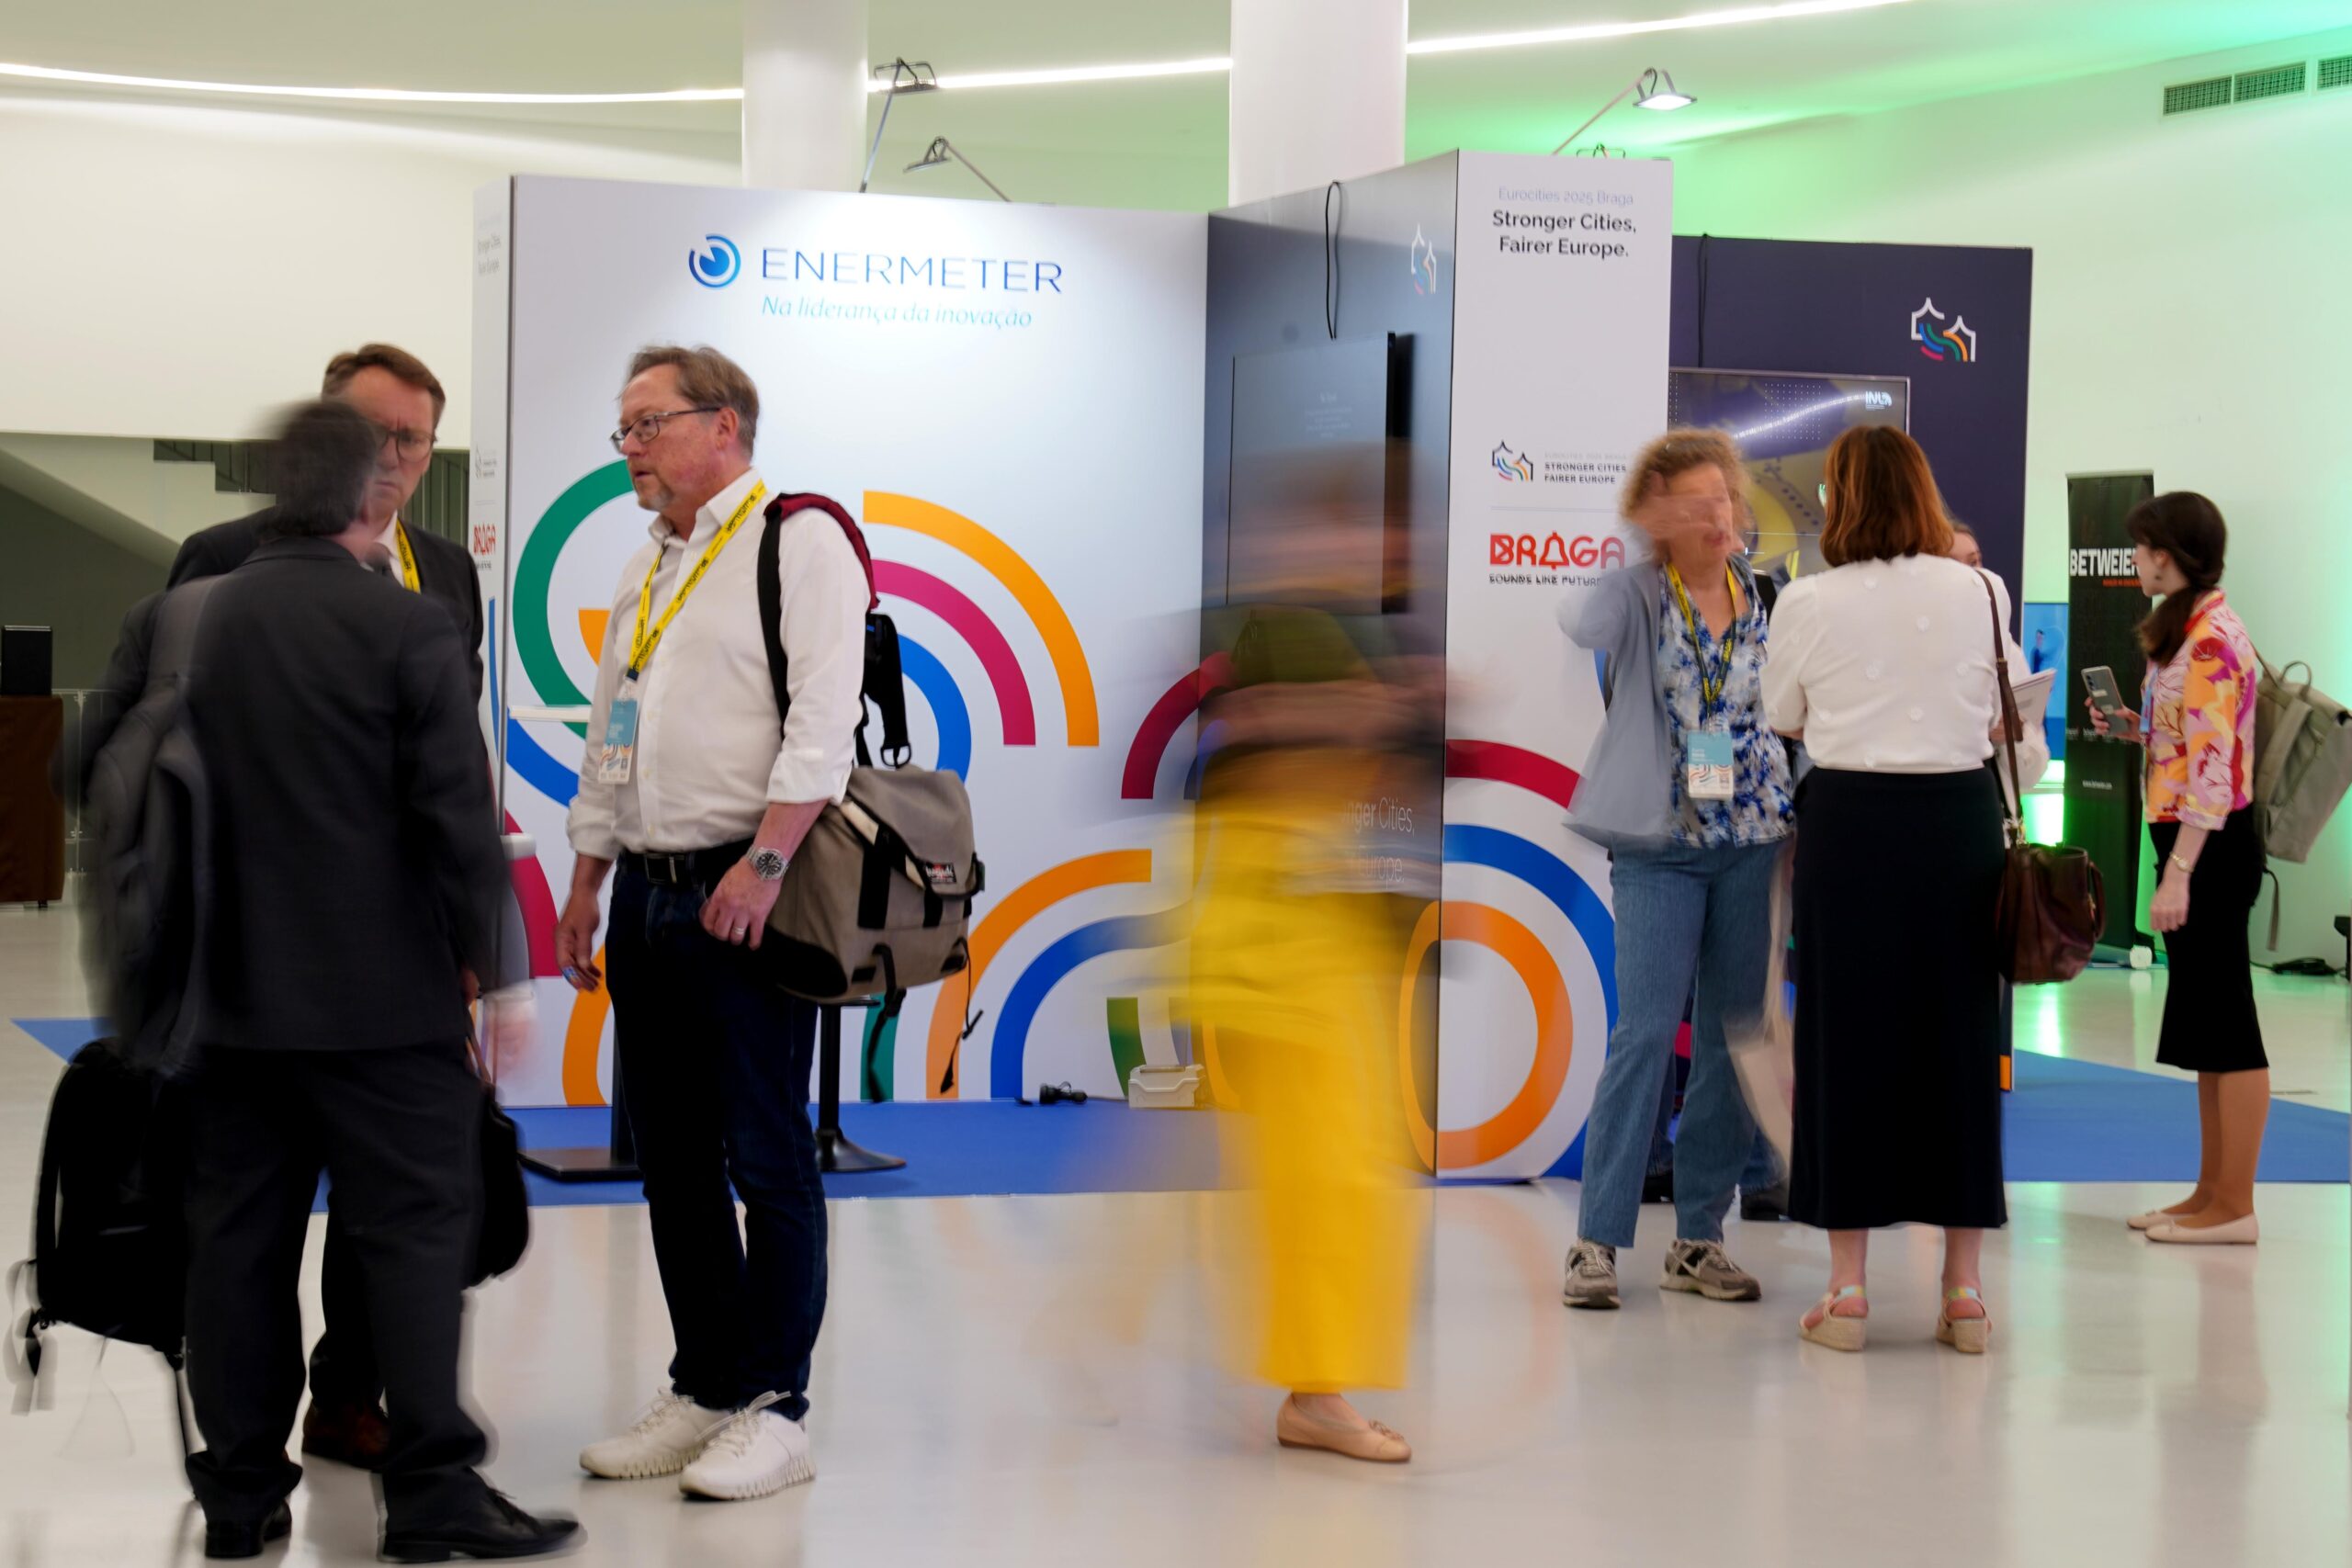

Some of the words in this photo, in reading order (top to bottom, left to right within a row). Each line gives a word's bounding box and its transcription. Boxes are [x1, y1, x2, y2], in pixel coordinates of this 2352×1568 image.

[1498, 186, 1560, 202] Eurocities
[1564, 191, 1594, 205] 2025
[1597, 190, 1634, 208] Braga
[1493, 209, 1576, 233] Stronger
[1580, 212, 1636, 233] Cities,
[1499, 235, 1554, 254] Fairer
[1558, 237, 1628, 260] Europe.
[762, 246, 1063, 295] ENERMETER
[762, 295, 792, 317] Na
[797, 297, 899, 325] liderança
[902, 299, 930, 321] da
[934, 304, 1033, 330] inovação
[1544, 461, 1594, 472] STRONGER
[1597, 463, 1626, 473] CITIES
[1544, 473, 1576, 483] FAIRER
[1578, 474, 1617, 485] EUROPE
[1489, 530, 1625, 571] BRAGA
[1489, 573, 1532, 586] SOUNDS
[1535, 574, 1558, 586] LIKE
[1378, 796, 1415, 838] Cities,
